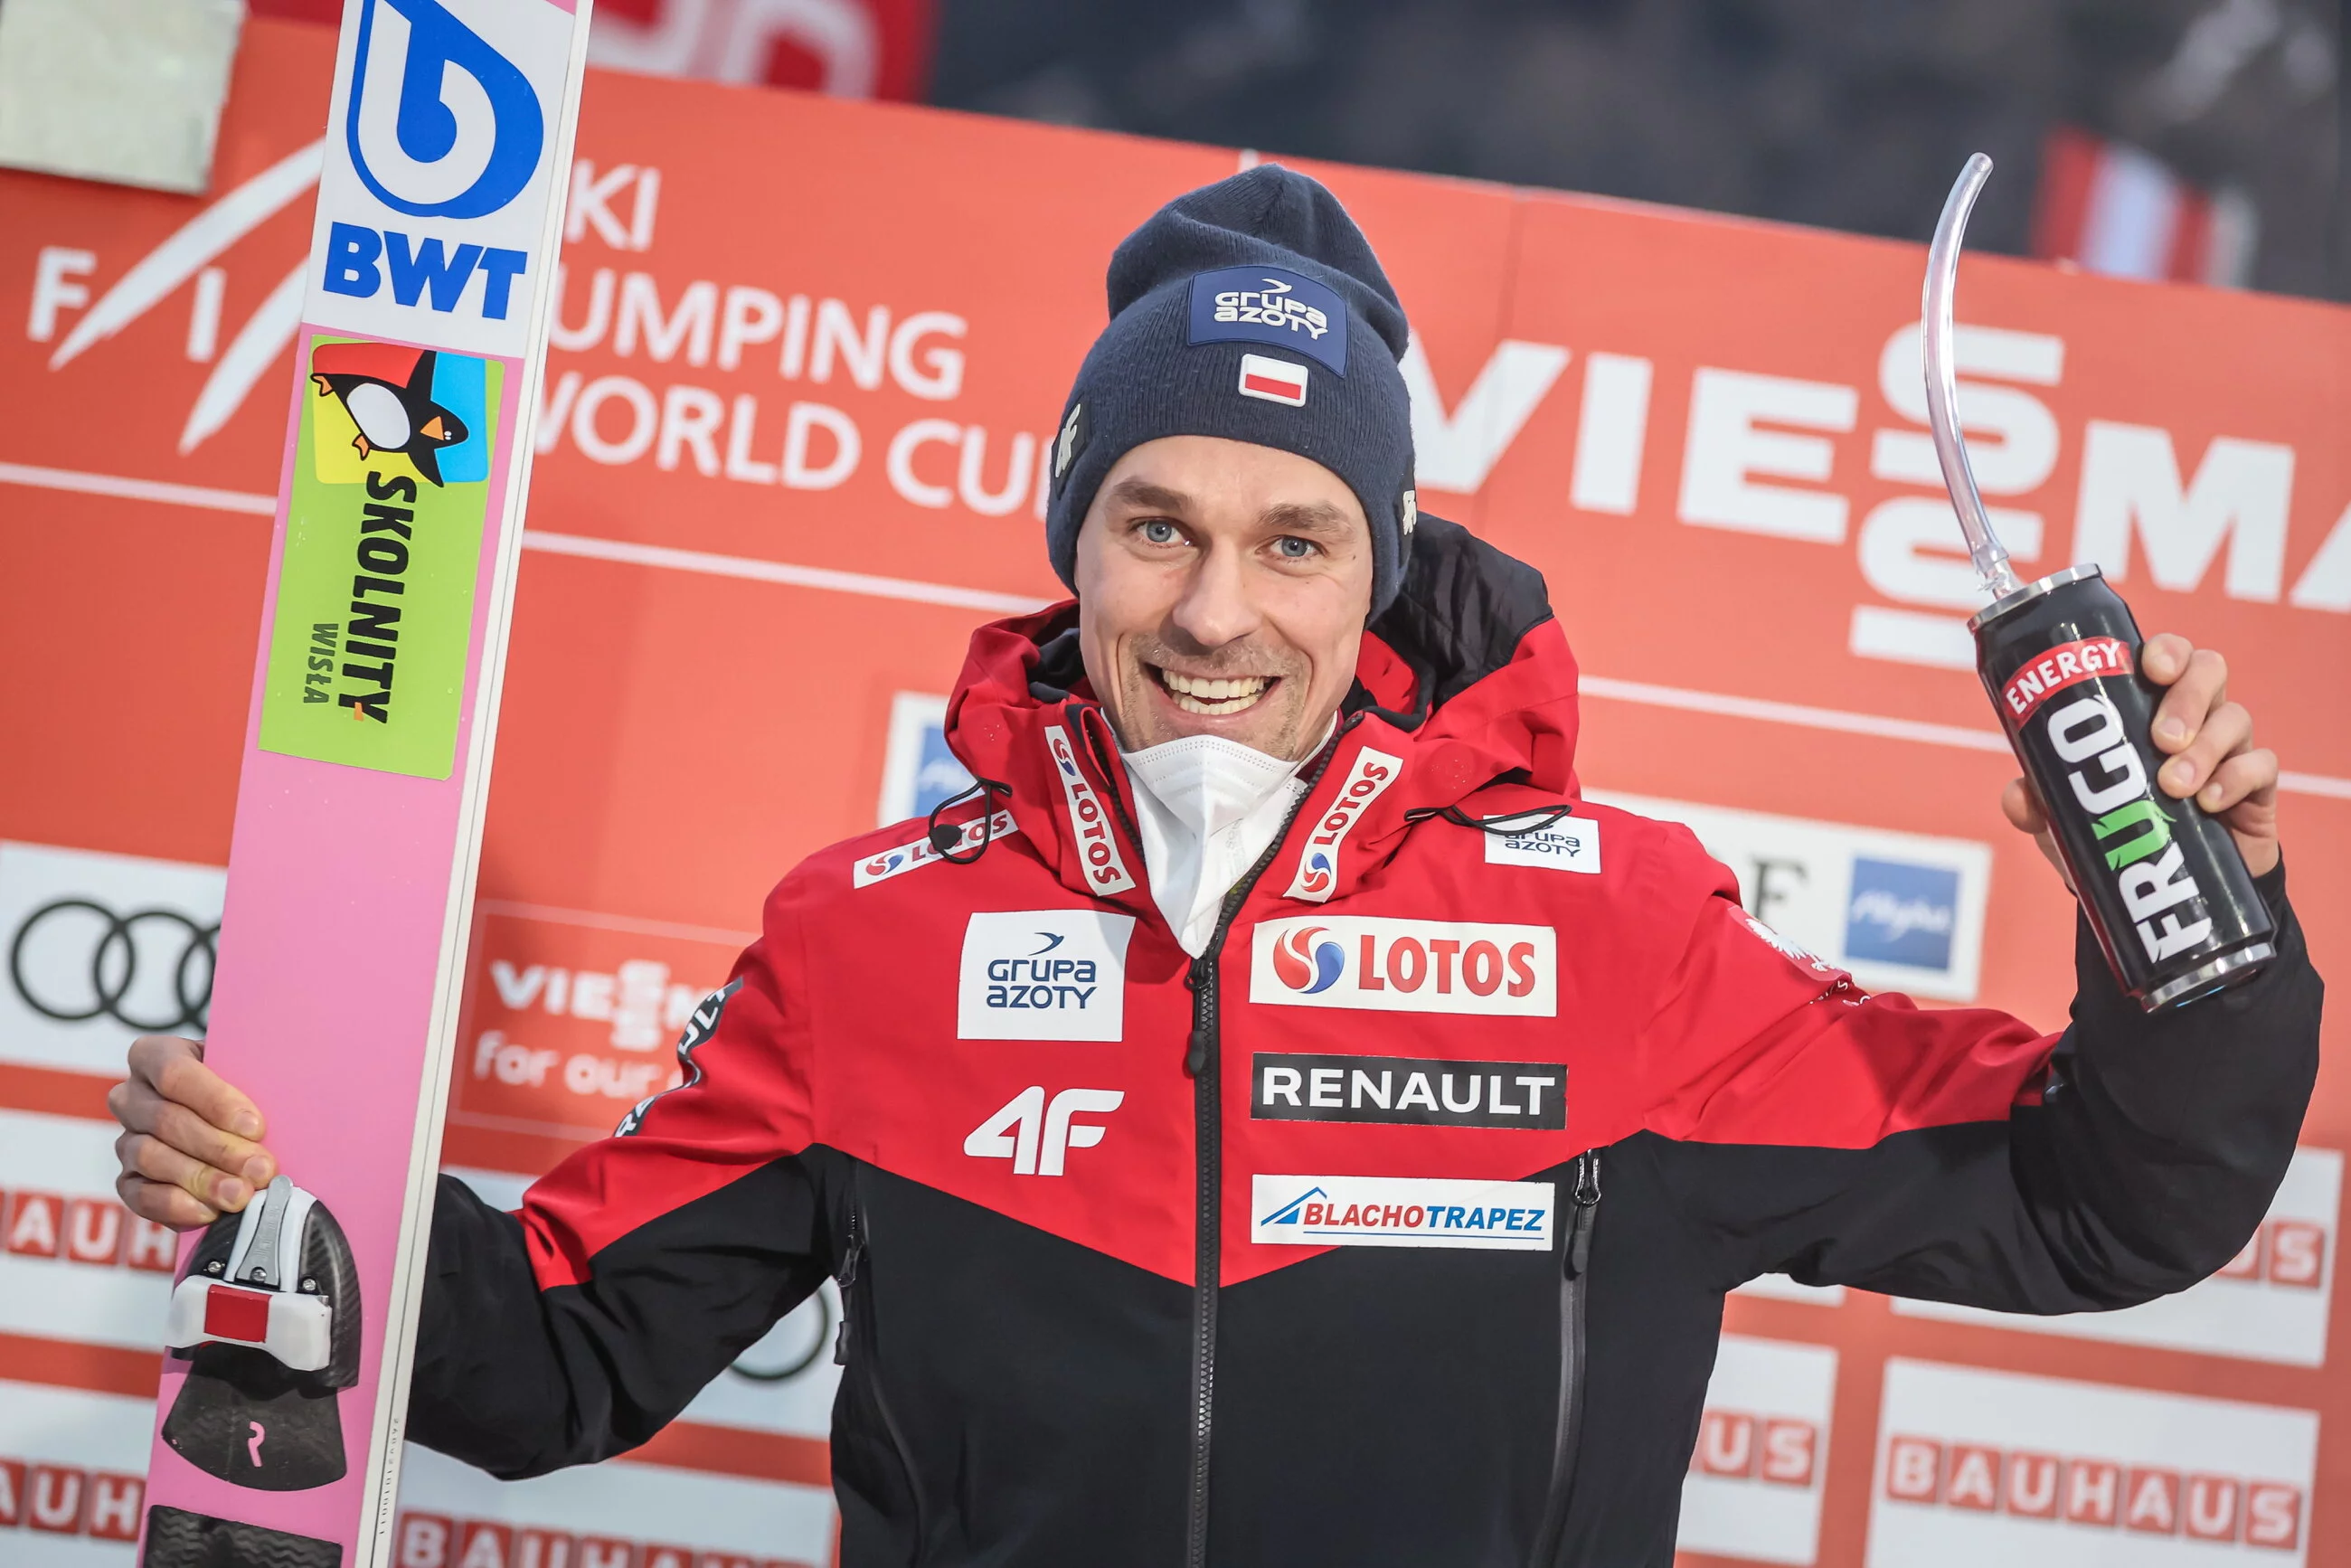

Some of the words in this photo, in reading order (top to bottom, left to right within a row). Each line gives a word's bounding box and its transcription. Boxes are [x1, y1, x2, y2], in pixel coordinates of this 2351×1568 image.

[564, 160, 661, 252] KI
[323, 222, 528, 321] BWT
[548, 263, 968, 402] UMPING
[886, 419, 1051, 523] CU
[338, 470, 418, 724] SKOLNITY
[2005, 639, 2122, 715] ENERGY
[911, 814, 1008, 863] LOS
[1072, 782, 1122, 886] LOTOS
[1313, 761, 1389, 846] LOTOS
[2047, 694, 2214, 965] FRUGO
[1357, 933, 1536, 997] LOTOS
[963, 1085, 1126, 1176] 4F
[1261, 1066, 1556, 1117] RENAULT
[1303, 1203, 1546, 1232] BLACHOTRAPEZ
[1890, 1441, 2297, 1541] BAUHAUS
